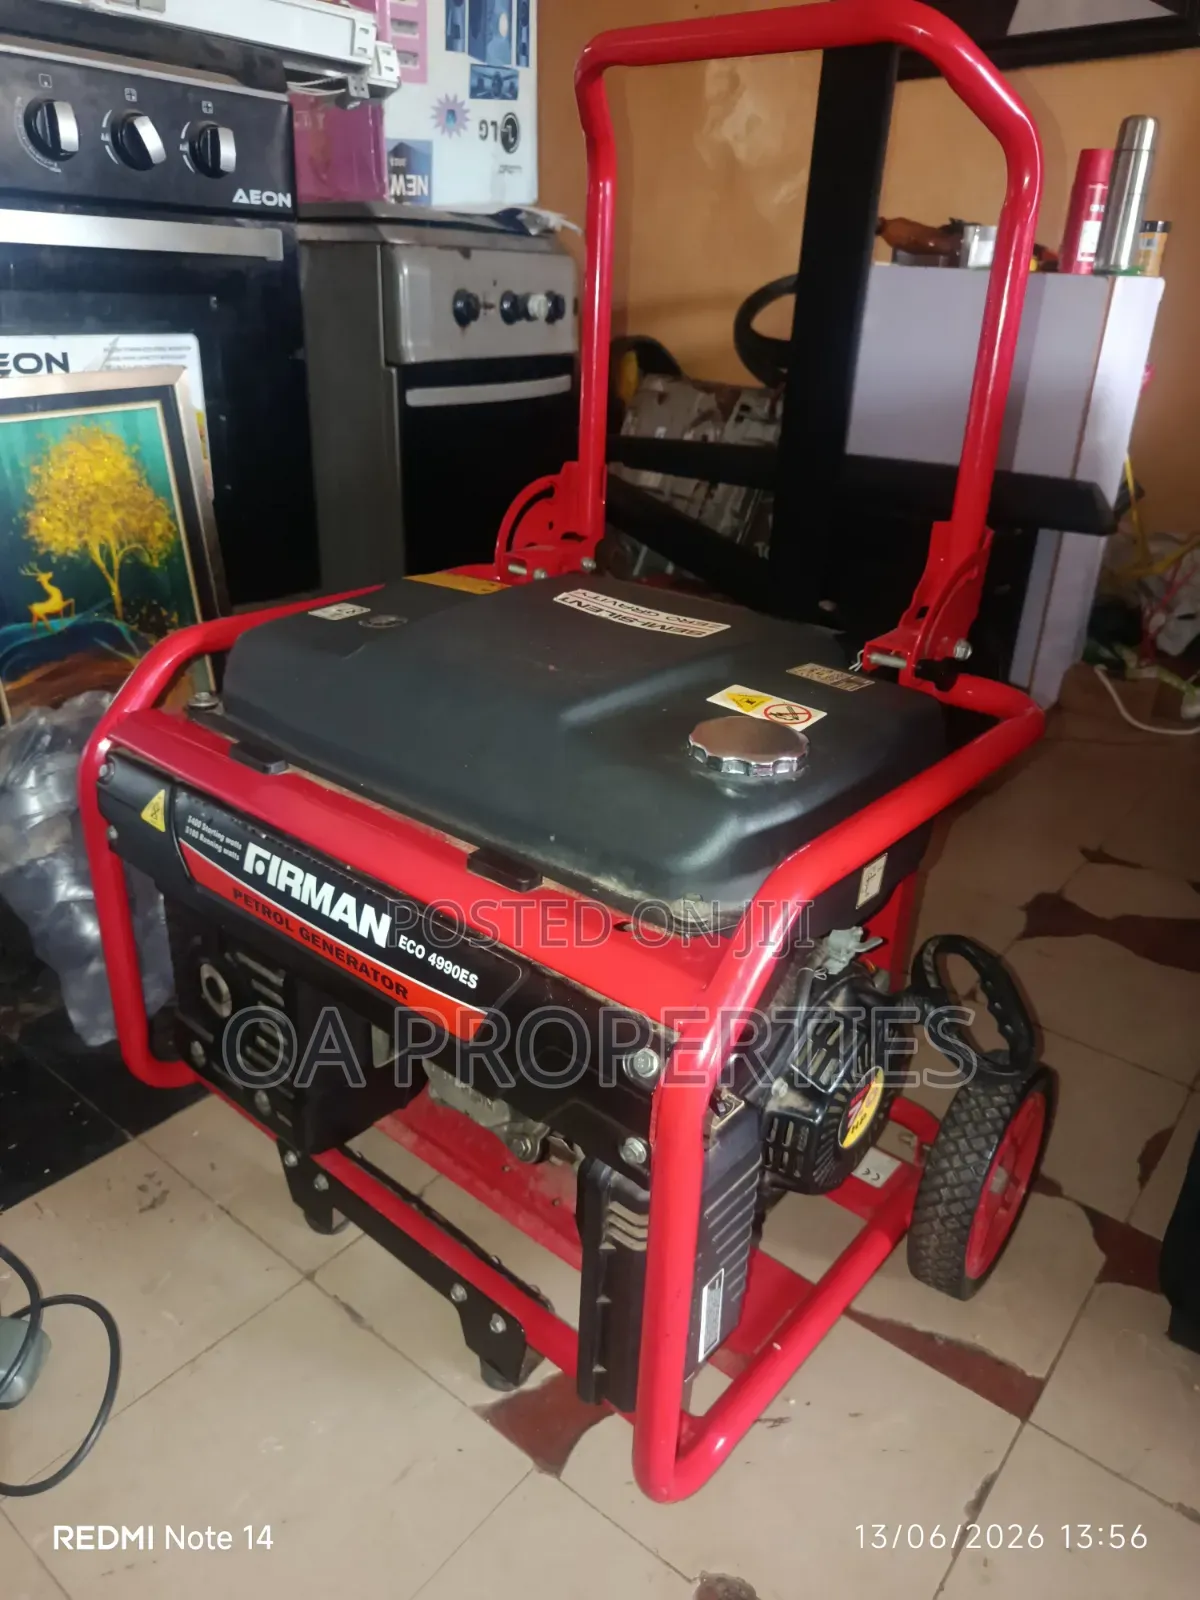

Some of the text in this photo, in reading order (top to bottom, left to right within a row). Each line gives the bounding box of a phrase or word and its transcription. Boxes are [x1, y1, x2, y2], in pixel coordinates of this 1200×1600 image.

[479, 119, 498, 142] LG
[390, 174, 428, 197] NEW
[232, 188, 292, 208] AEON
[558, 597, 707, 636] SEMI-SILENT
[575, 592, 660, 617] GRAVITY
[199, 833, 222, 853] Running
[201, 823, 225, 842] Starting
[243, 842, 392, 948] FIRMAN
[233, 886, 408, 1000] PETROL GENERATOR
[398, 935, 479, 990] ECO 4990ES
